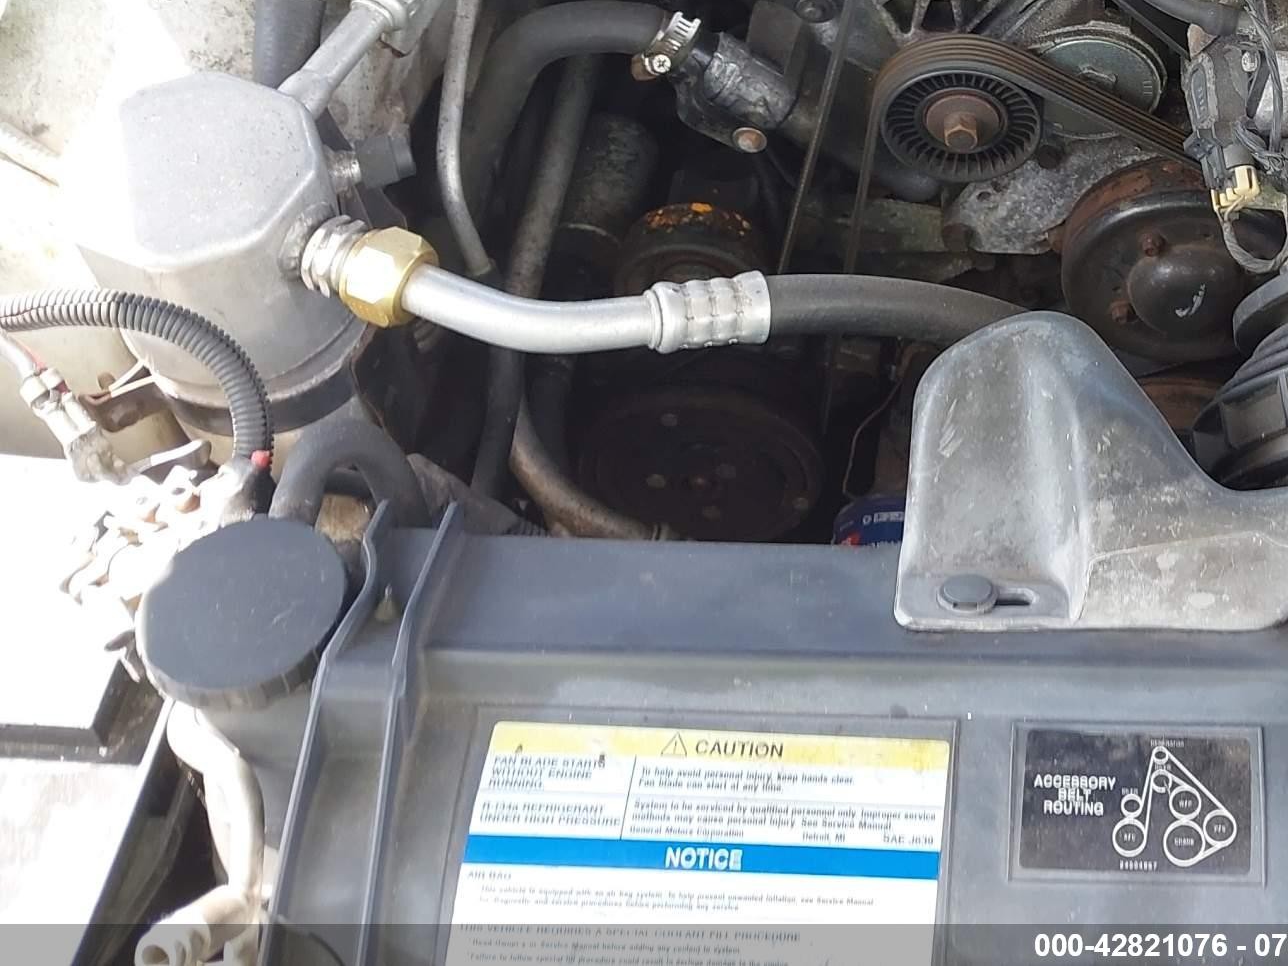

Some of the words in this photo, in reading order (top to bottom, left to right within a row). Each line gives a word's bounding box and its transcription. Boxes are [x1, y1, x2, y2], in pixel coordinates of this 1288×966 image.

[695, 738, 784, 758] CAUTION
[493, 755, 517, 766] FAN
[520, 756, 558, 767] BLADE
[562, 758, 606, 769] STARTS
[491, 765, 543, 777] WITHOUT
[548, 769, 593, 779] ENGINE
[654, 766, 674, 778] help
[677, 768, 701, 777] avoid
[704, 770, 744, 781] personal
[801, 773, 828, 783] hands
[638, 778, 655, 787] Fan
[658, 778, 684, 788] blade
[686, 780, 703, 788] can
[706, 781, 728, 790] start
[730, 781, 740, 790] at
[743, 783, 759, 794] any
[1033, 773, 1116, 791] ACCESSORY
[1058, 787, 1092, 802] BELT
[522, 803, 605, 814] REFRIGERANT
[634, 799, 668, 812] System
[695, 802, 735, 812] serviced
[736, 802, 748, 815] by
[750, 803, 790, 817] qualified
[791, 806, 836, 820] personnel
[860, 808, 902, 822] Improper
[904, 810, 937, 822] service
[1043, 799, 1104, 816] ROUTING
[479, 813, 520, 823] UNDER
[524, 814, 555, 825] HIGH
[558, 816, 622, 827] PRESSURE
[631, 811, 671, 822] methods
[674, 814, 694, 825] may
[697, 814, 724, 824] cause
[727, 816, 767, 827] personal
[801, 818, 818, 828] See
[821, 819, 856, 830] Service
[629, 826, 662, 836] General
[664, 826, 694, 837] Motors
[696, 828, 745, 840] Corporation
[883, 833, 906, 844] SAE
[664, 846, 743, 872] NOTICE
